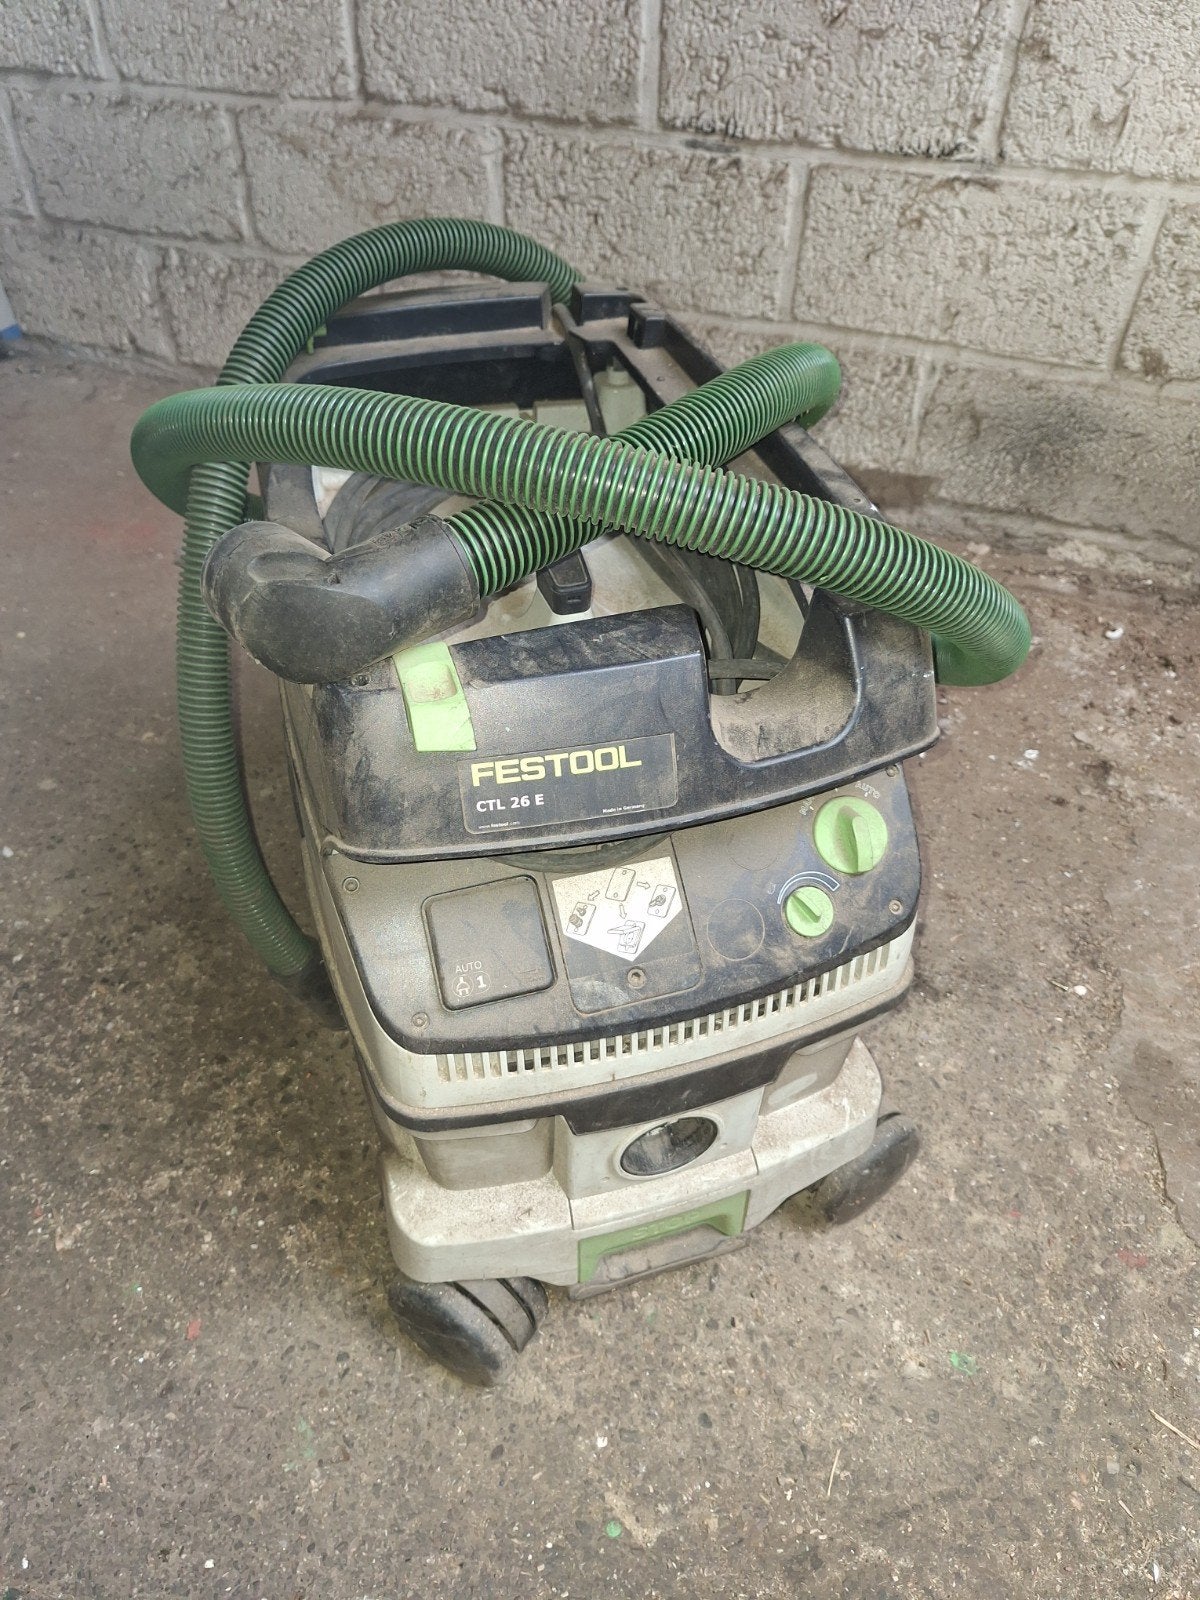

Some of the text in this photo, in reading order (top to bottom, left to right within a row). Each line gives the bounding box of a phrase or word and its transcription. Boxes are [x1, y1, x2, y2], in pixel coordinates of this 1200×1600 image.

[470, 745, 643, 787] FESTOOL
[855, 780, 880, 799] AUTO
[476, 794, 545, 813] CTL 26 E
[623, 803, 646, 811] Germany
[455, 960, 482, 974] AUTO
[476, 975, 487, 989] 1
